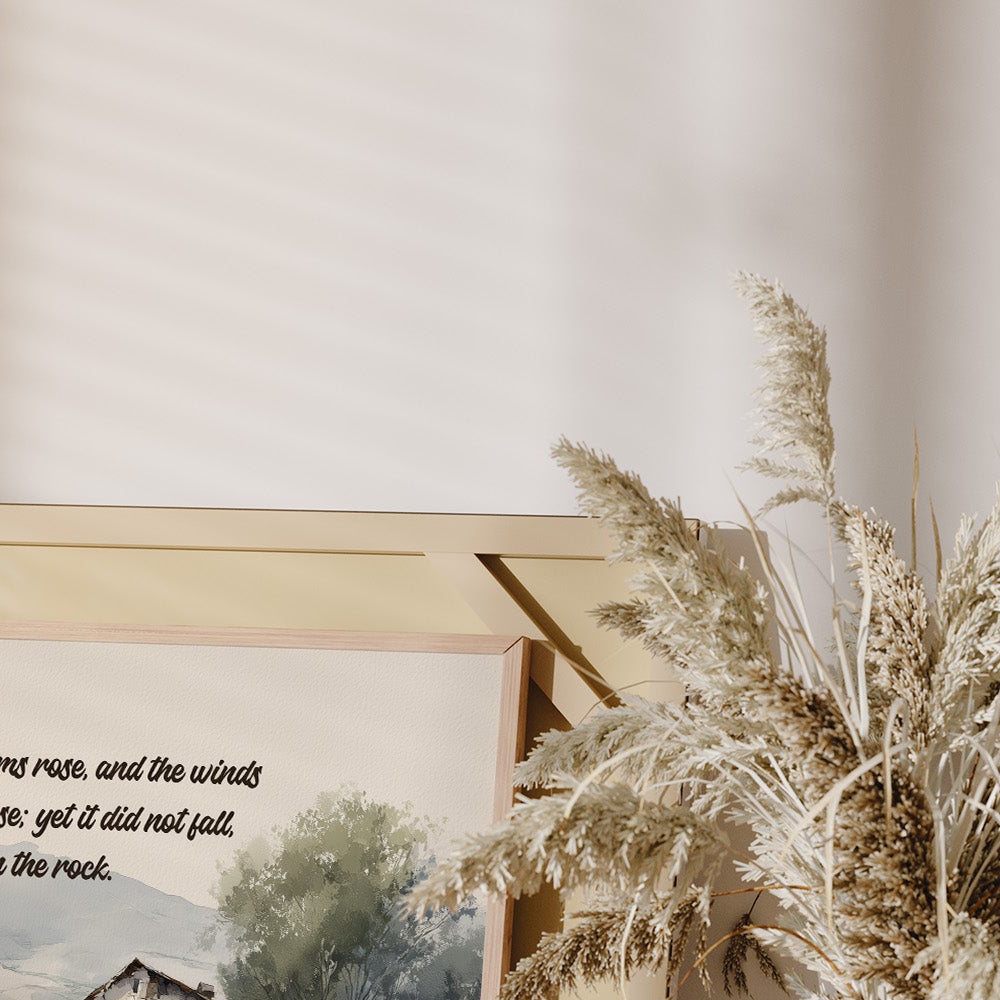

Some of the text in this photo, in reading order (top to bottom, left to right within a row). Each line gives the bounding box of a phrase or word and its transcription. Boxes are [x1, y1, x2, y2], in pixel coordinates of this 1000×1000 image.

[31, 756, 88, 782] rose,
[95, 756, 147, 782] and
[147, 756, 186, 783] the
[190, 759, 262, 789] winds
[31, 803, 78, 838] yet
[77, 804, 101, 830] it
[100, 805, 145, 832] did
[143, 807, 190, 834] not
[187, 810, 235, 841] fall,
[10, 851, 48, 878] the
[51, 855, 112, 881] rock.
